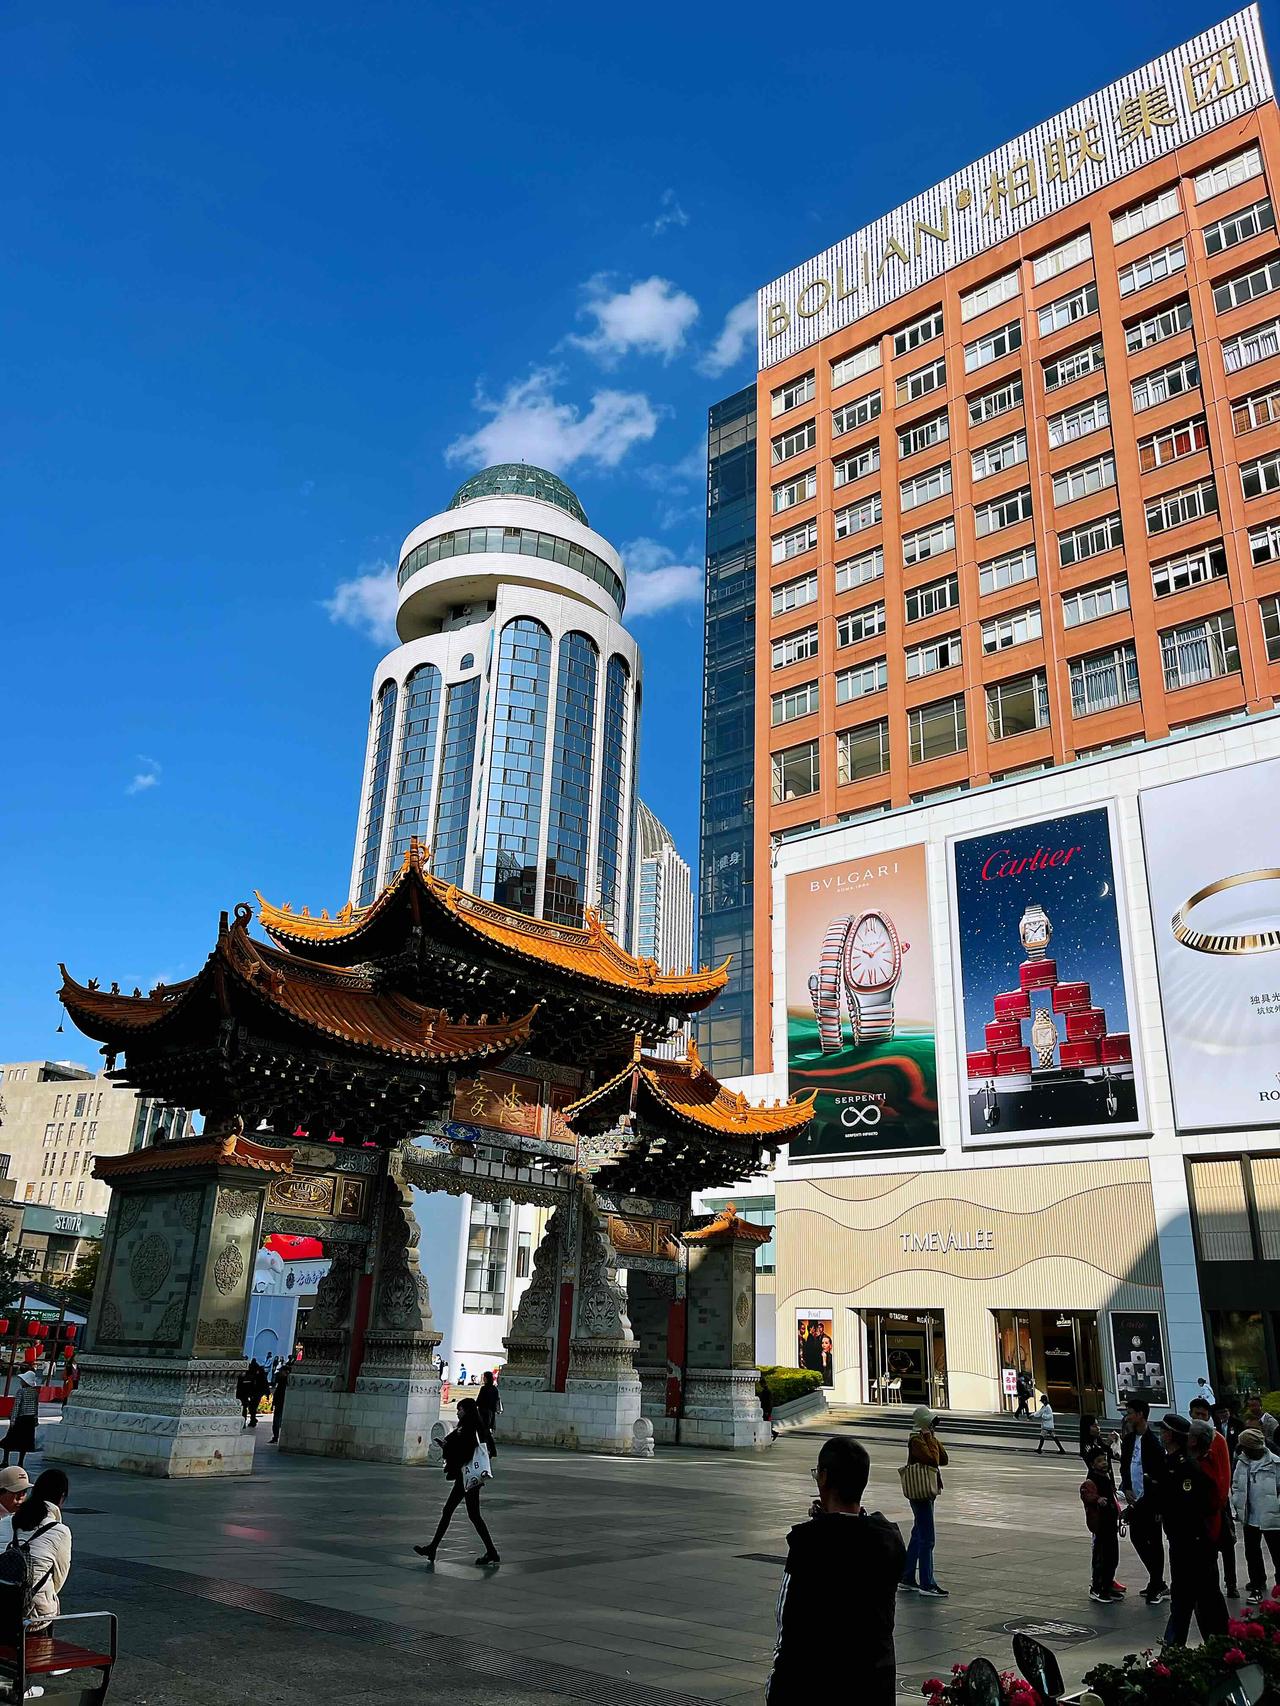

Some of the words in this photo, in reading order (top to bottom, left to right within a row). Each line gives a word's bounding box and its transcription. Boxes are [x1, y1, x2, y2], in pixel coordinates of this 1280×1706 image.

[982, 35, 1252, 220] 柏联集团
[766, 206, 950, 340] BOLIAN
[981, 844, 1082, 880] Cartier
[810, 863, 898, 892] BVLGARI
[1250, 992, 1280, 1005] 独具光
[835, 1093, 886, 1104] SERPENTI
[1259, 1090, 1280, 1101] RO
[56, 1215, 82, 1232] SEMIR
[474, 1461, 480, 1469] B
